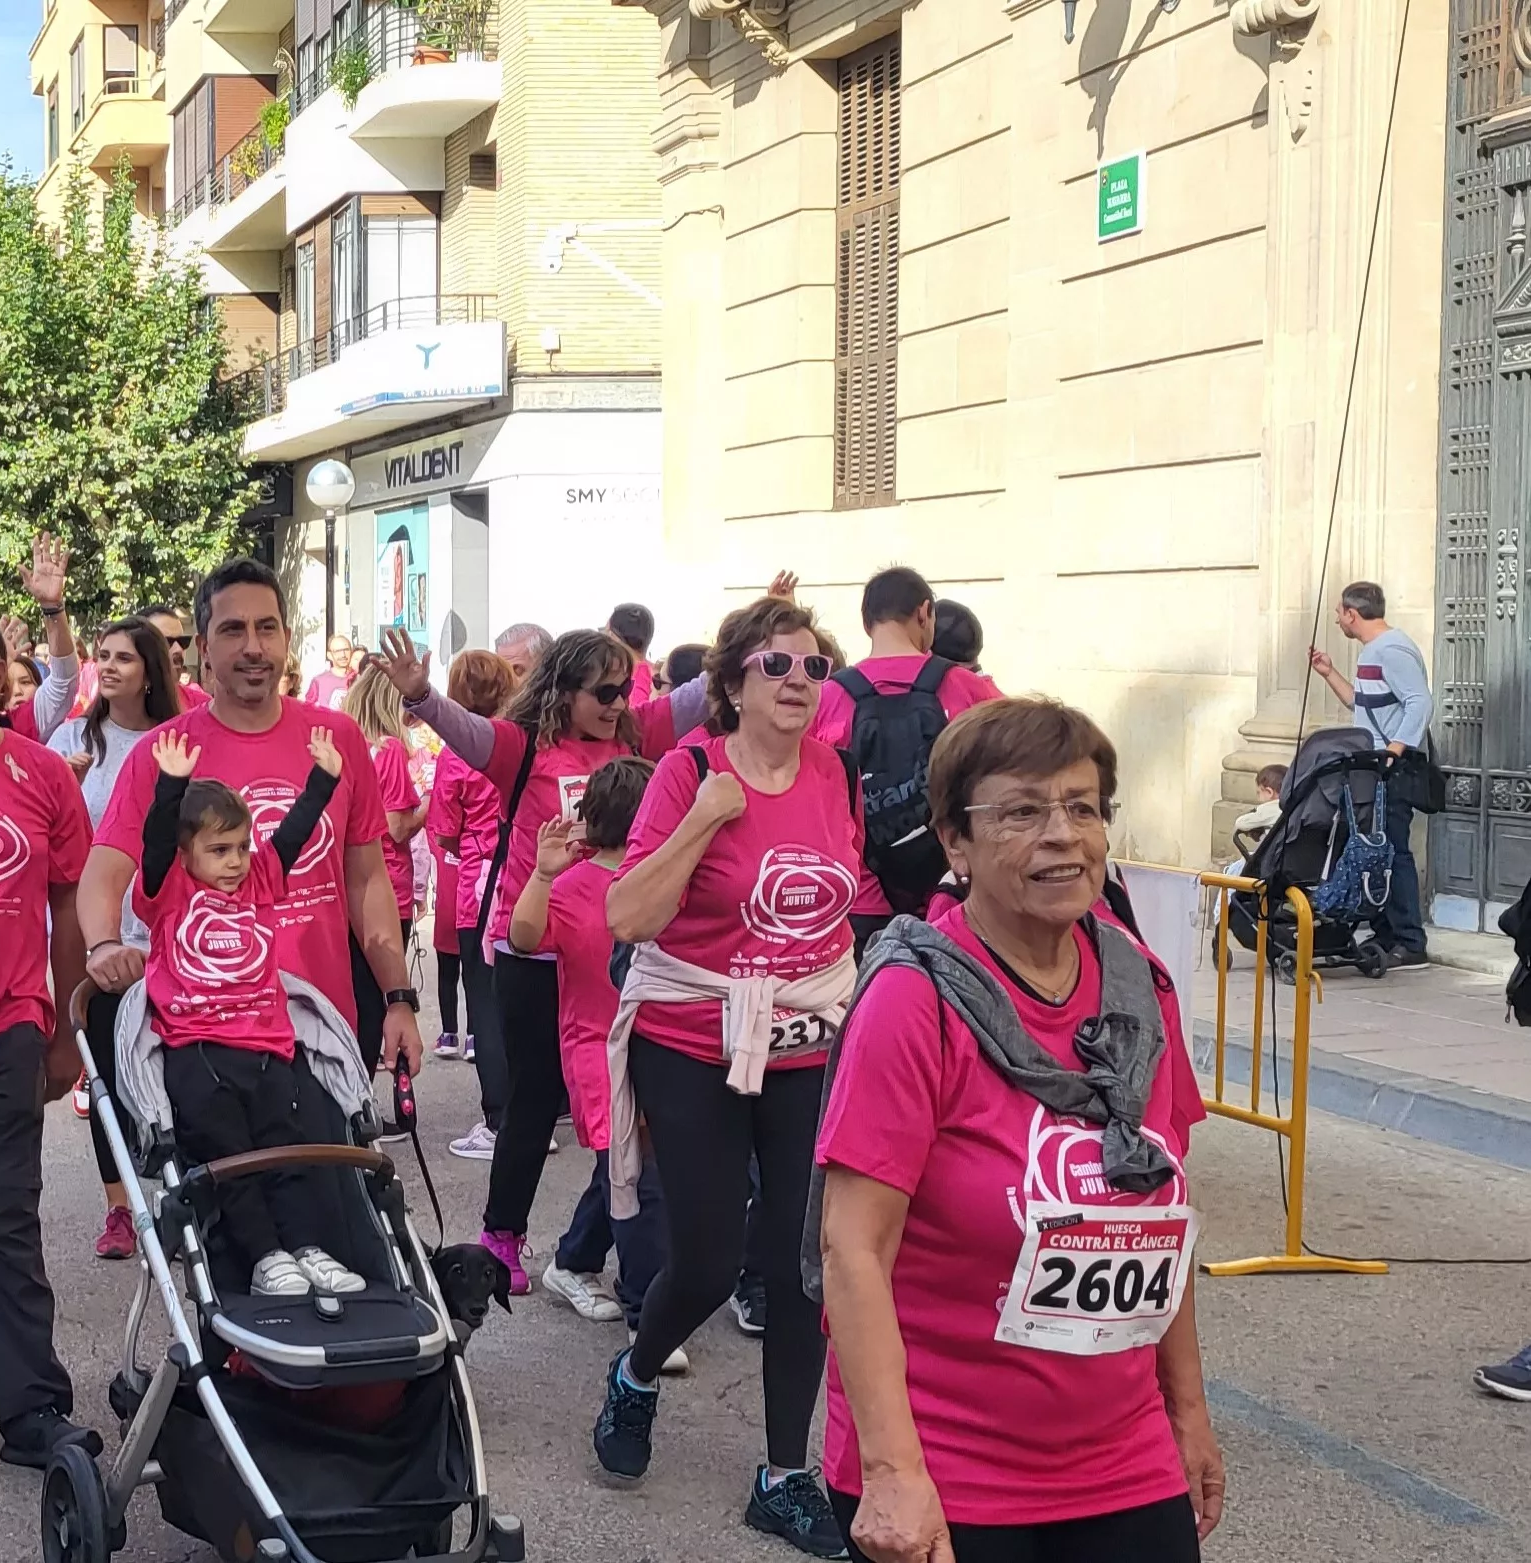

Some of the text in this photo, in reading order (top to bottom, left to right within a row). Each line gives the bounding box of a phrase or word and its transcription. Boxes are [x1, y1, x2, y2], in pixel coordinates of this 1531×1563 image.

[384, 441, 464, 489] VITALDENT
[566, 487, 607, 504] SMY
[1042, 1222, 1049, 1230] X
[1104, 1224, 1142, 1235] HUESCA
[1049, 1233, 1179, 1250] CONTRA EL CÁNCER
[1029, 1256, 1173, 1313] 2604
